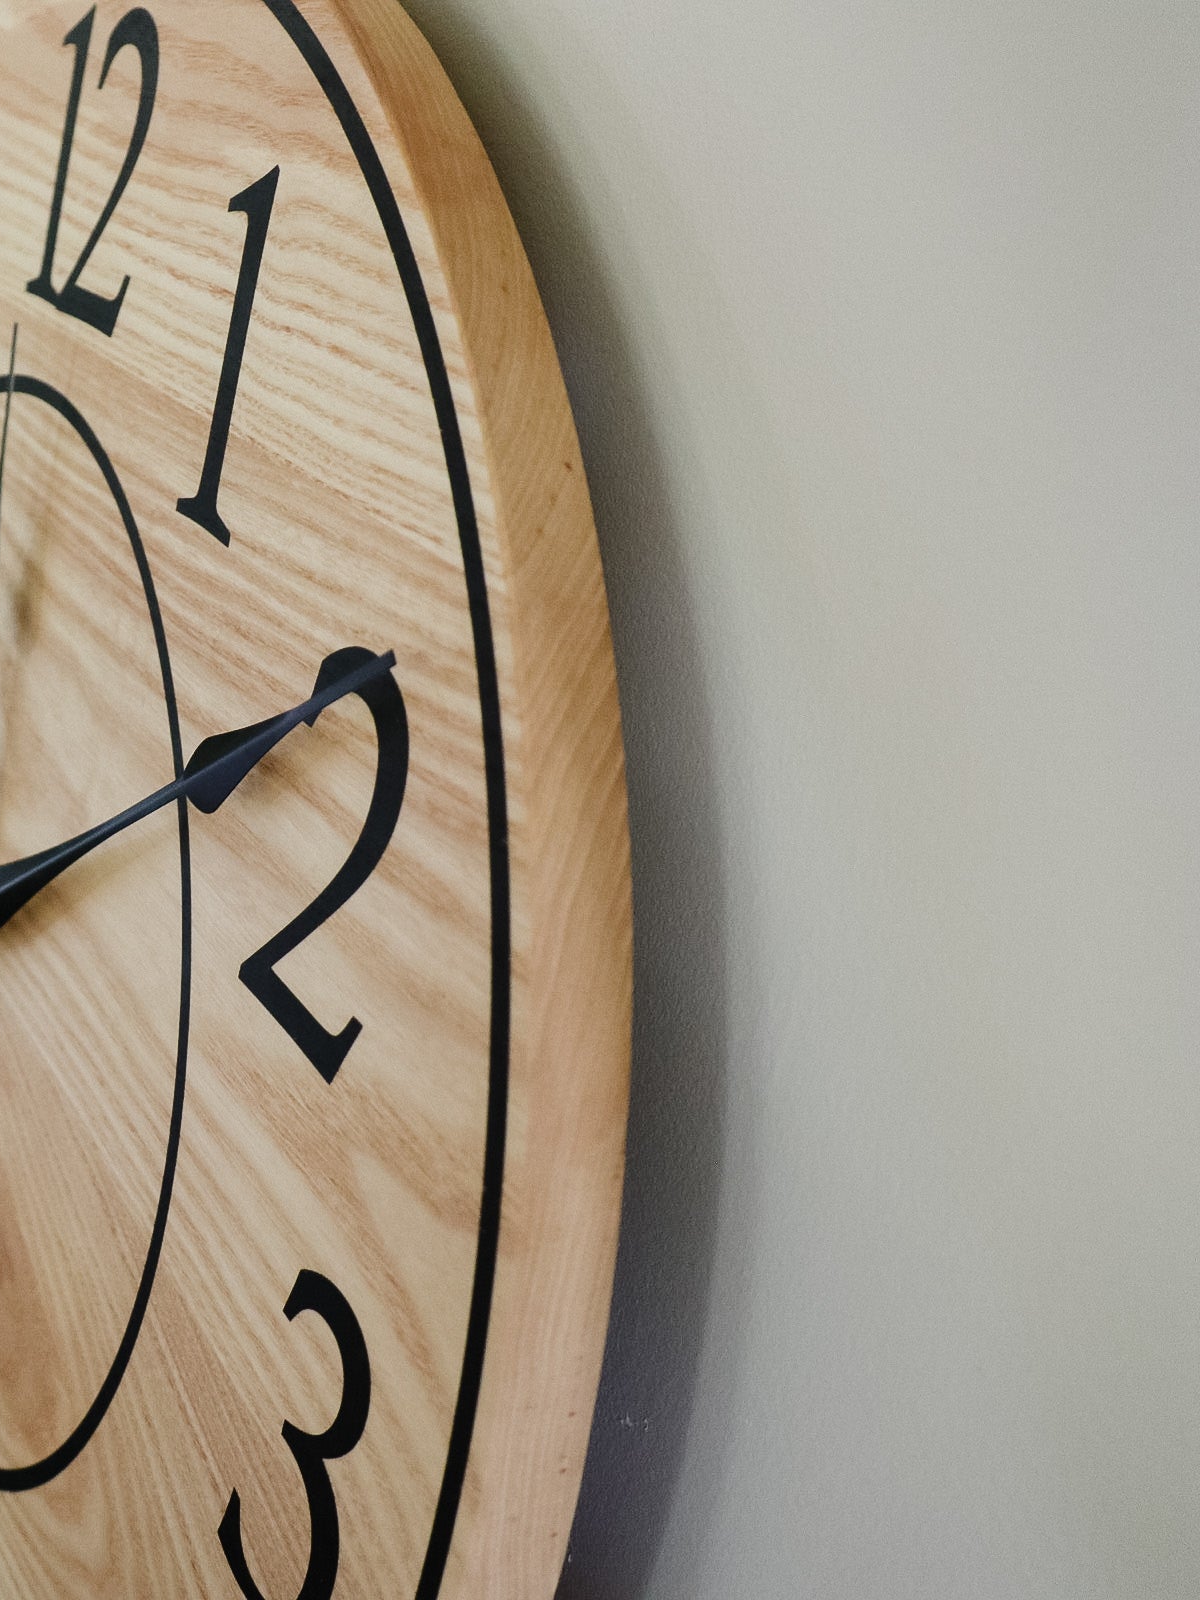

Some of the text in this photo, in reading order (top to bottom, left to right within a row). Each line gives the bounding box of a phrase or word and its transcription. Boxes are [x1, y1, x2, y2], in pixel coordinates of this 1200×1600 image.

[26, 4, 160, 338] 12
[175, 164, 281, 548] 1
[238, 645, 410, 1085] 2
[217, 1268, 372, 1600] 3
